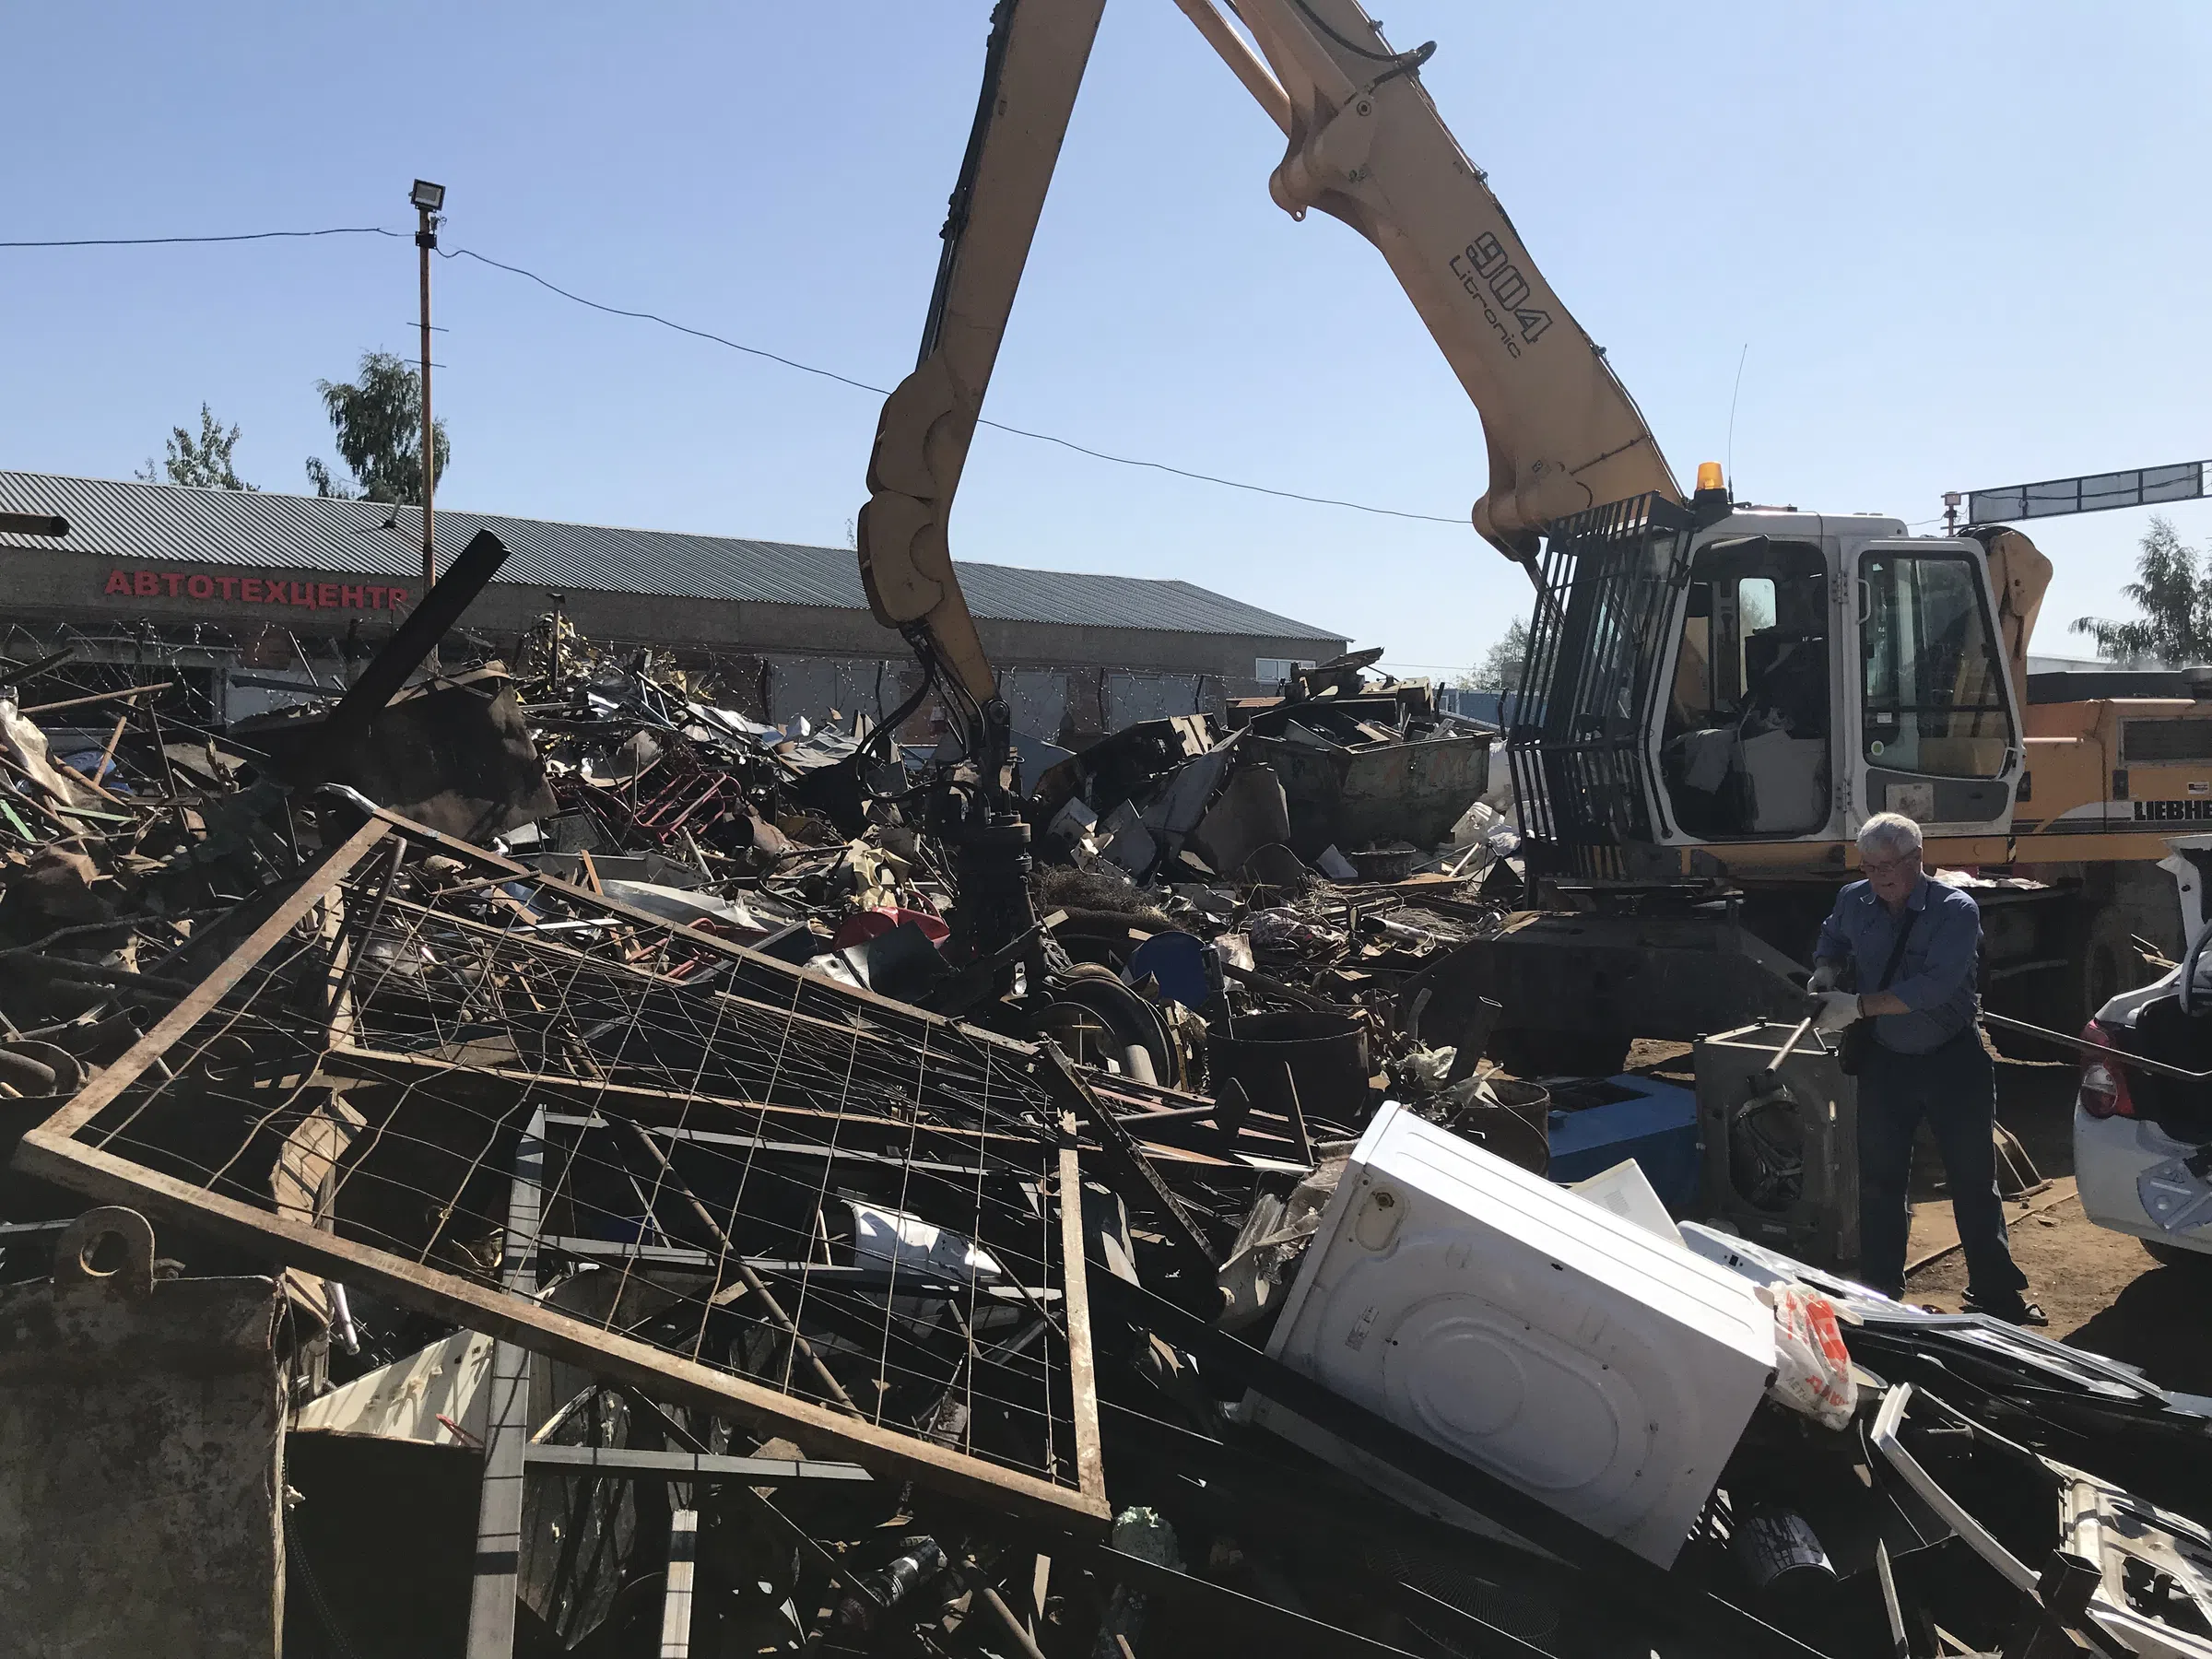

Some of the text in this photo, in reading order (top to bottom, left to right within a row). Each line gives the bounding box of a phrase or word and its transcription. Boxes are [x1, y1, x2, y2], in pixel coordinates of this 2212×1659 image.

[1449, 254, 1521, 359] Litronic
[1465, 231, 1553, 345] 904
[104, 570, 408, 610] АВТОТЕХЦЕНТР
